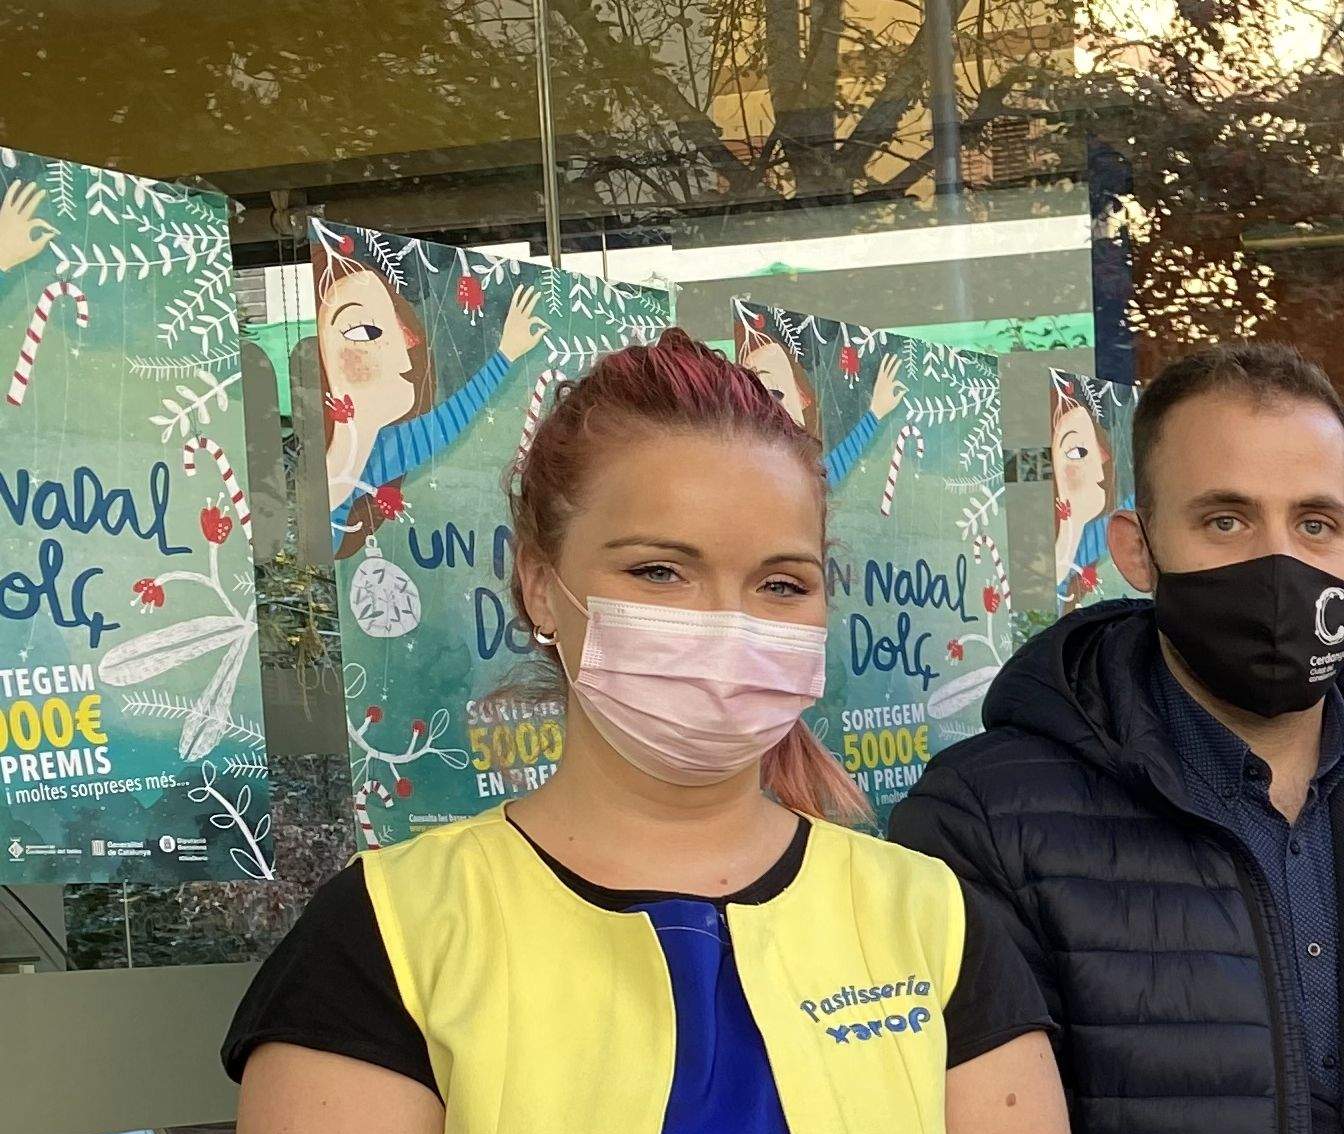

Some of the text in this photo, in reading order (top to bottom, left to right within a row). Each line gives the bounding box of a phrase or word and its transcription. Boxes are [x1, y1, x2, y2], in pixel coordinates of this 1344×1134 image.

[408, 522, 475, 570] UN
[0, 538, 121, 648] olç
[827, 557, 851, 597] N
[475, 587, 535, 660] Do
[851, 612, 940, 691] Dolç
[0, 664, 96, 698] TEGEM
[0, 694, 109, 751] 00€
[842, 703, 925, 732] SORTEGEM
[0, 746, 112, 784] PREMIS
[469, 719, 563, 771] 5000
[843, 725, 931, 773] 5000€
[15, 783, 68, 803] moltes
[71, 778, 143, 801] sorpreses
[476, 764, 558, 797] EN PRE
